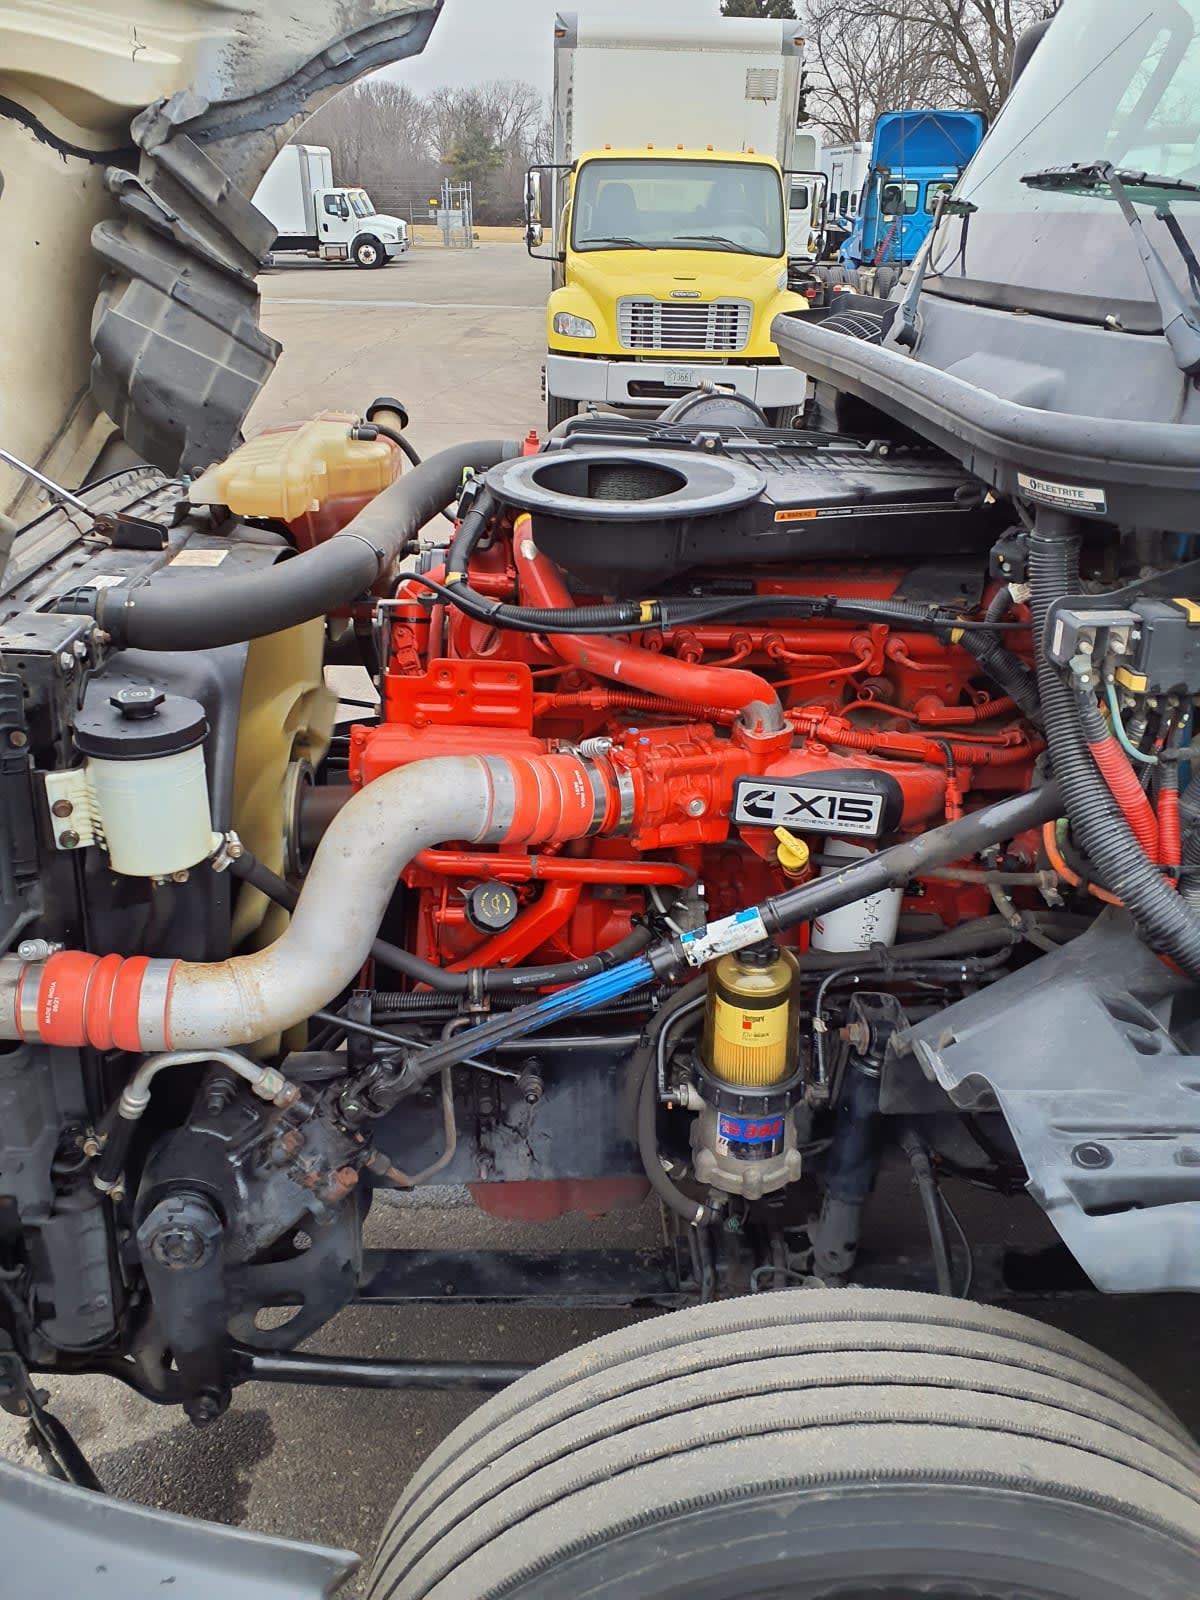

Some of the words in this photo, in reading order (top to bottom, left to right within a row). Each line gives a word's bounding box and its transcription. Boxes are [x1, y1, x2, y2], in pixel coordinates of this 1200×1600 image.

[1036, 482, 1085, 498] FLEETRITE
[785, 792, 873, 823] X15
[782, 816, 835, 827] EFFICIENCY
[837, 821, 872, 830] SERIES
